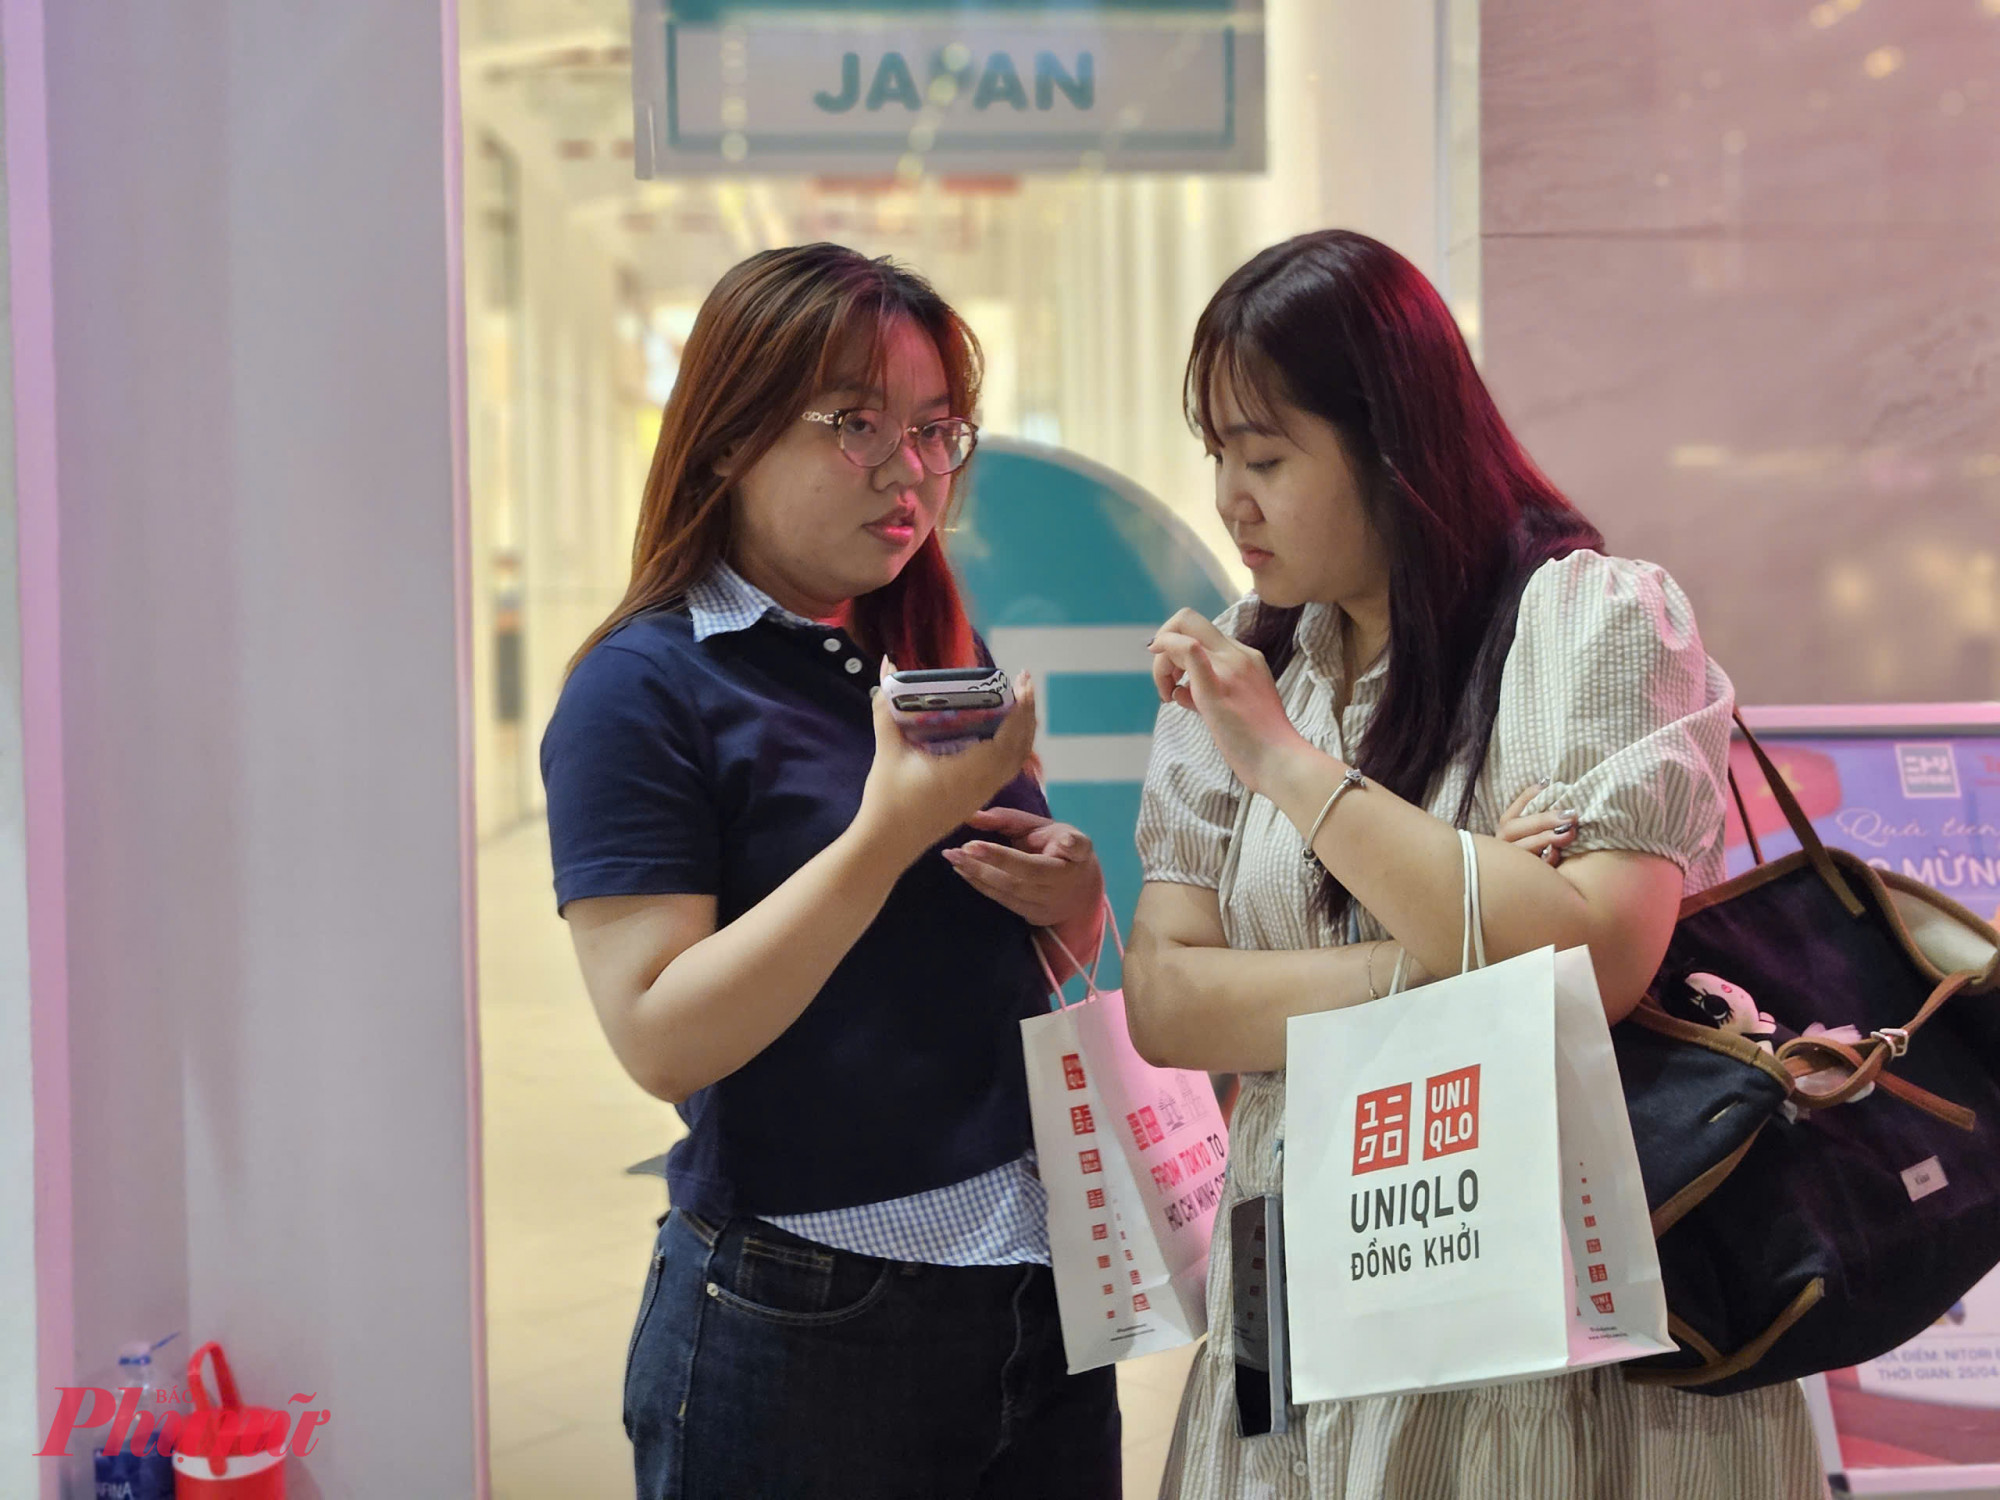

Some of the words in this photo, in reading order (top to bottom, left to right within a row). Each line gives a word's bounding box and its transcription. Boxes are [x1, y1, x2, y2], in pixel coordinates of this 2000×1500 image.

[1902, 847, 2000, 886] MỪN
[1431, 1077, 1470, 1113] UNI
[1207, 1133, 1225, 1160] TO
[1429, 1112, 1473, 1152] QLO
[1351, 1169, 1479, 1233] UNIQLO
[1351, 1237, 1411, 1281] ĐỒNG
[1424, 1222, 1480, 1268] KHỞI
